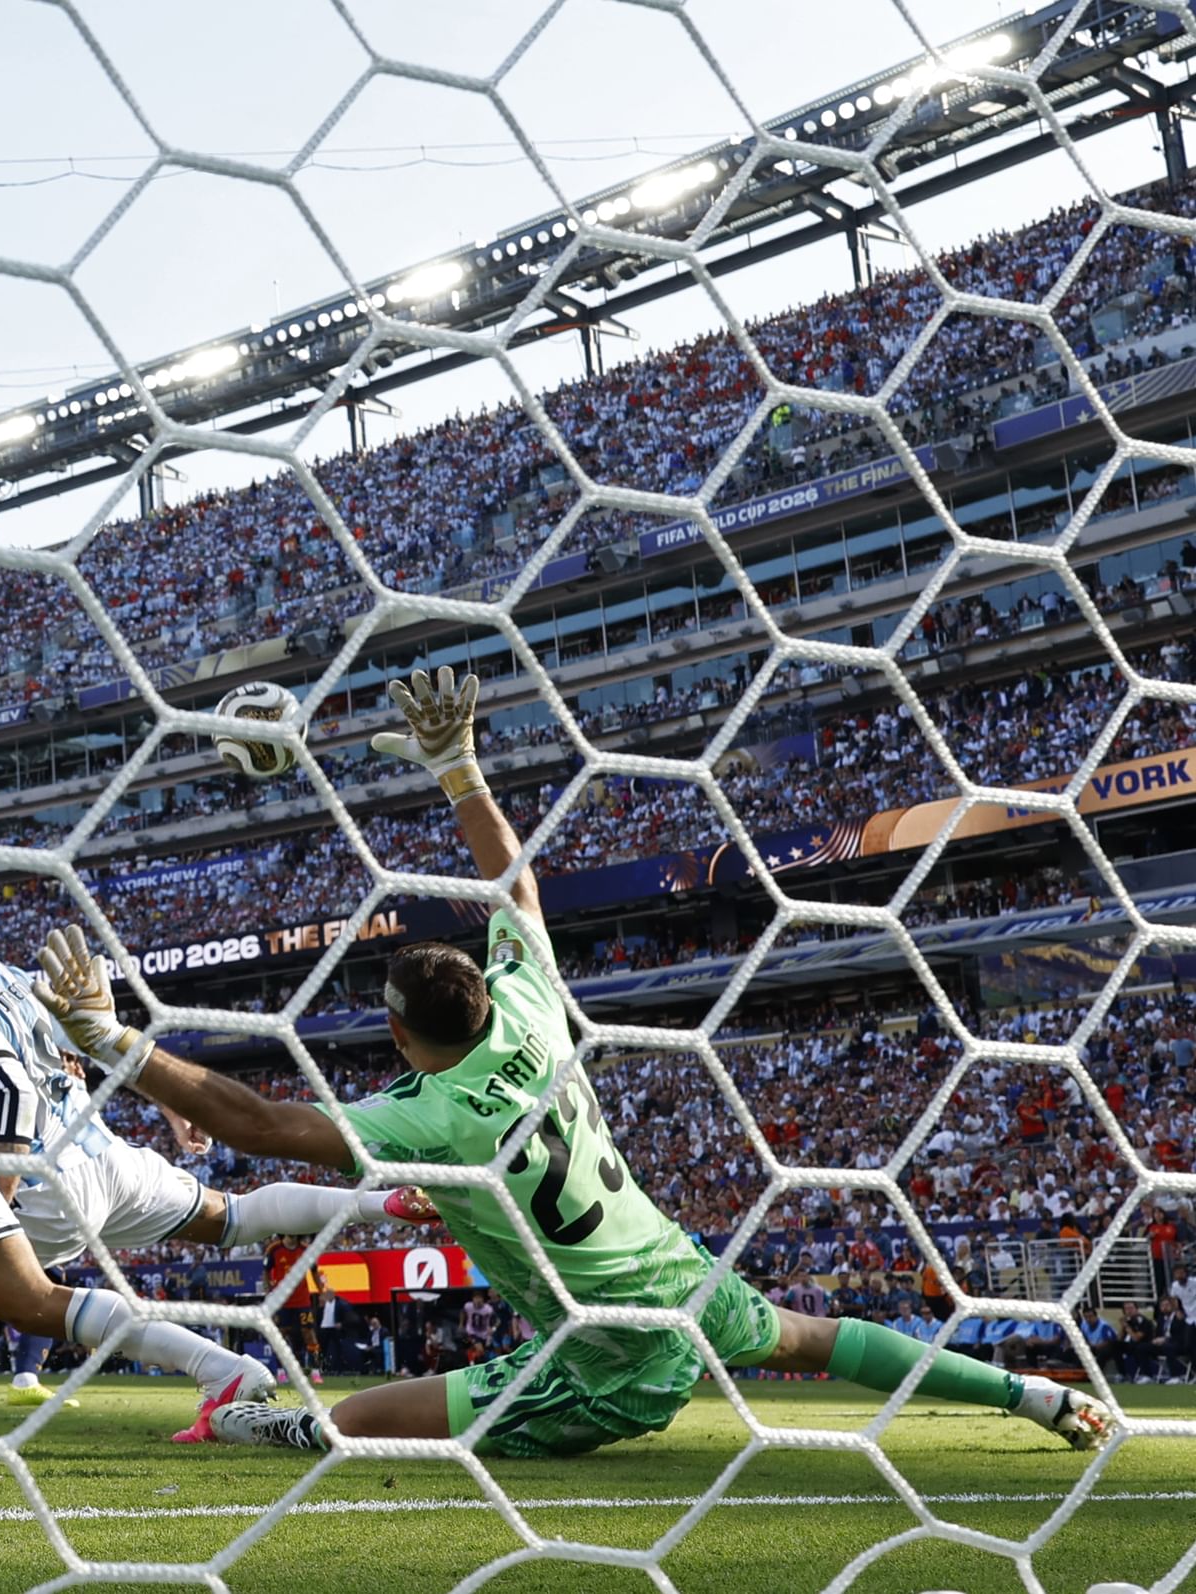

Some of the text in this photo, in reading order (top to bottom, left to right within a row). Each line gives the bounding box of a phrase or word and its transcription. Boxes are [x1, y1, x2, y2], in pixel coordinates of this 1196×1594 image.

[656, 461, 904, 548] FIFA WLD CUP 2026 THE FINA
[1091, 758, 1192, 800] YORK
[161, 866, 199, 884] NEW
[143, 948, 184, 975] CUP
[186, 935, 261, 969] 2026
[265, 924, 320, 956] THE
[499, 1060, 624, 1245] 23
[207, 1269, 245, 1287] INAL
[404, 1247, 449, 1302] 0
